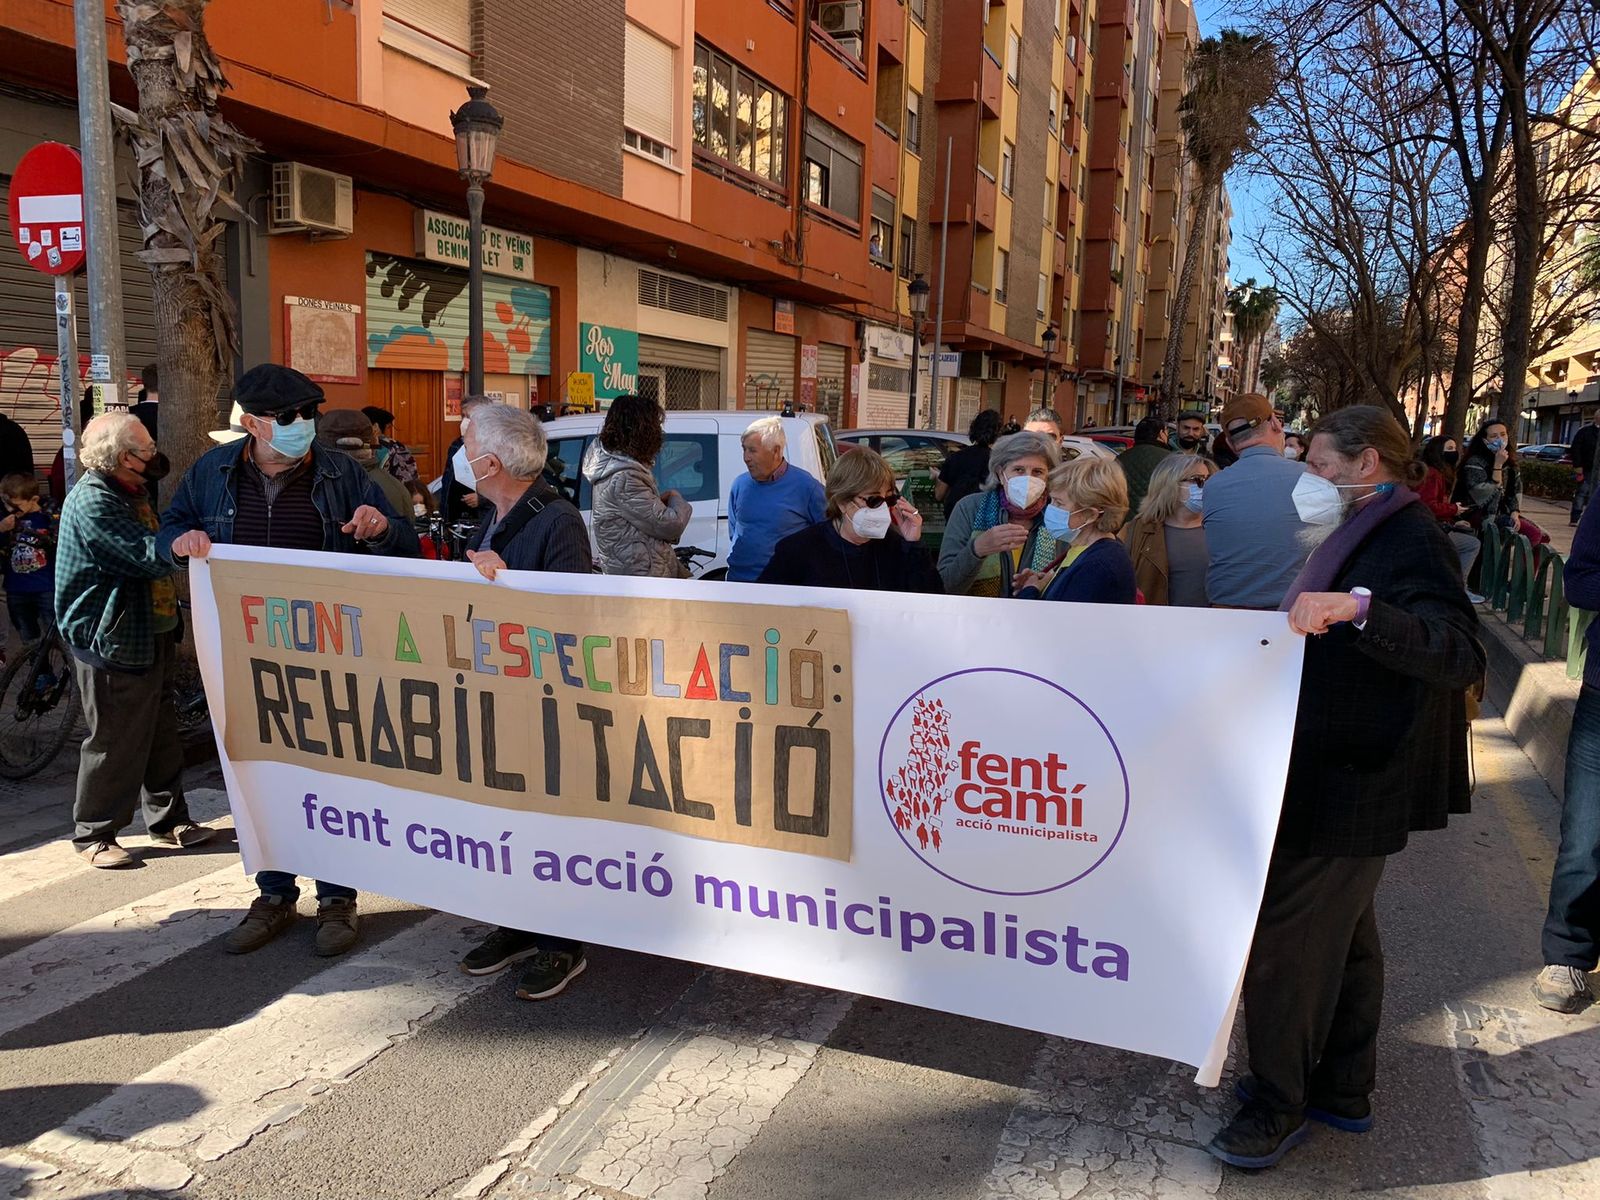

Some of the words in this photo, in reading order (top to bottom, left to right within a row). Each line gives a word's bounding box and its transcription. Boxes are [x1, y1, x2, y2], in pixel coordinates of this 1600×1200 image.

[427, 216, 487, 246] ASSOCIAÓ
[490, 231, 502, 249] DE
[505, 235, 532, 256] VEÏNS
[436, 239, 501, 267] BENIMLET
[298, 297, 322, 309] DONES
[585, 325, 615, 363] Ros
[602, 357, 612, 375] &
[603, 362, 638, 396] May
[240, 595, 363, 657] FRONT
[394, 611, 422, 664] A
[957, 740, 1068, 795] fent
[954, 782, 1088, 828] camí
[955, 817, 993, 831] acció
[997, 822, 1099, 843] municipalista
[301, 792, 392, 848] fent
[405, 822, 513, 876] camí
[532, 849, 674, 898] acció
[694, 873, 1130, 982] municipalista
